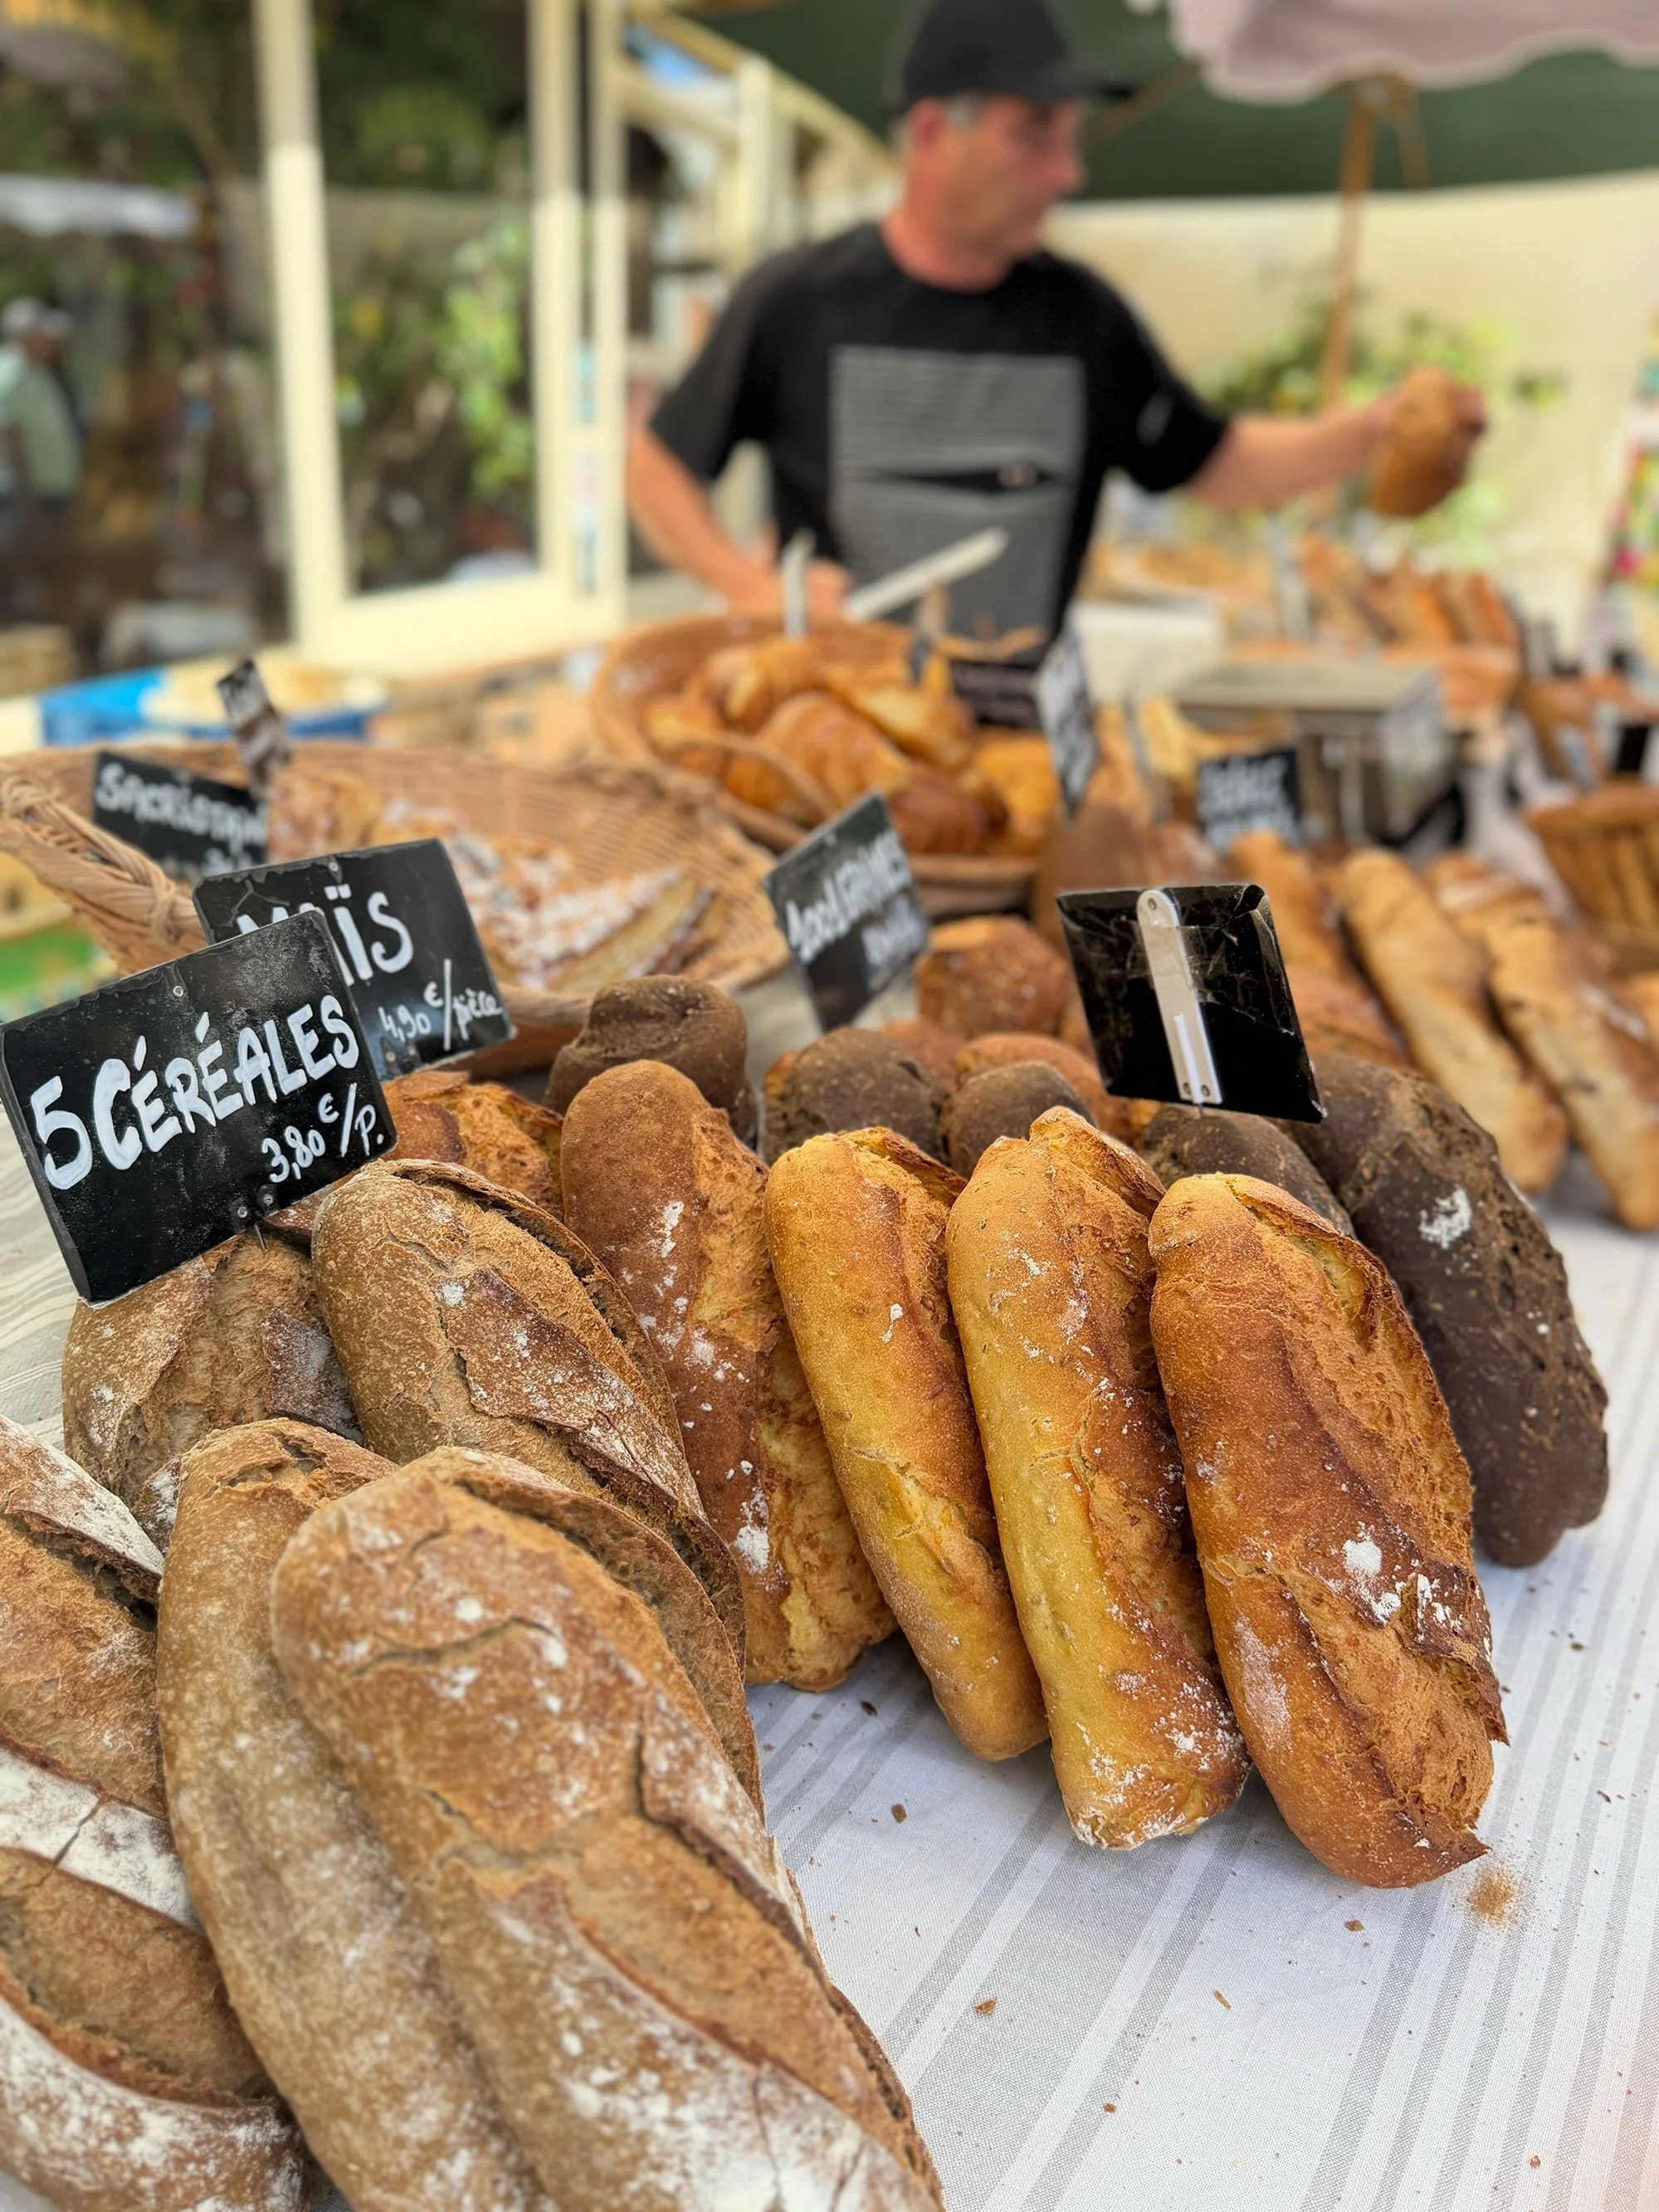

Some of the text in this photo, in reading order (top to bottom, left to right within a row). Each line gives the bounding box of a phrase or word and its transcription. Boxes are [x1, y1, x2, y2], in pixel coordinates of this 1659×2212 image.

[236, 883, 414, 986] ÏS
[30, 994, 359, 1190] 5 CÉRÉALES
